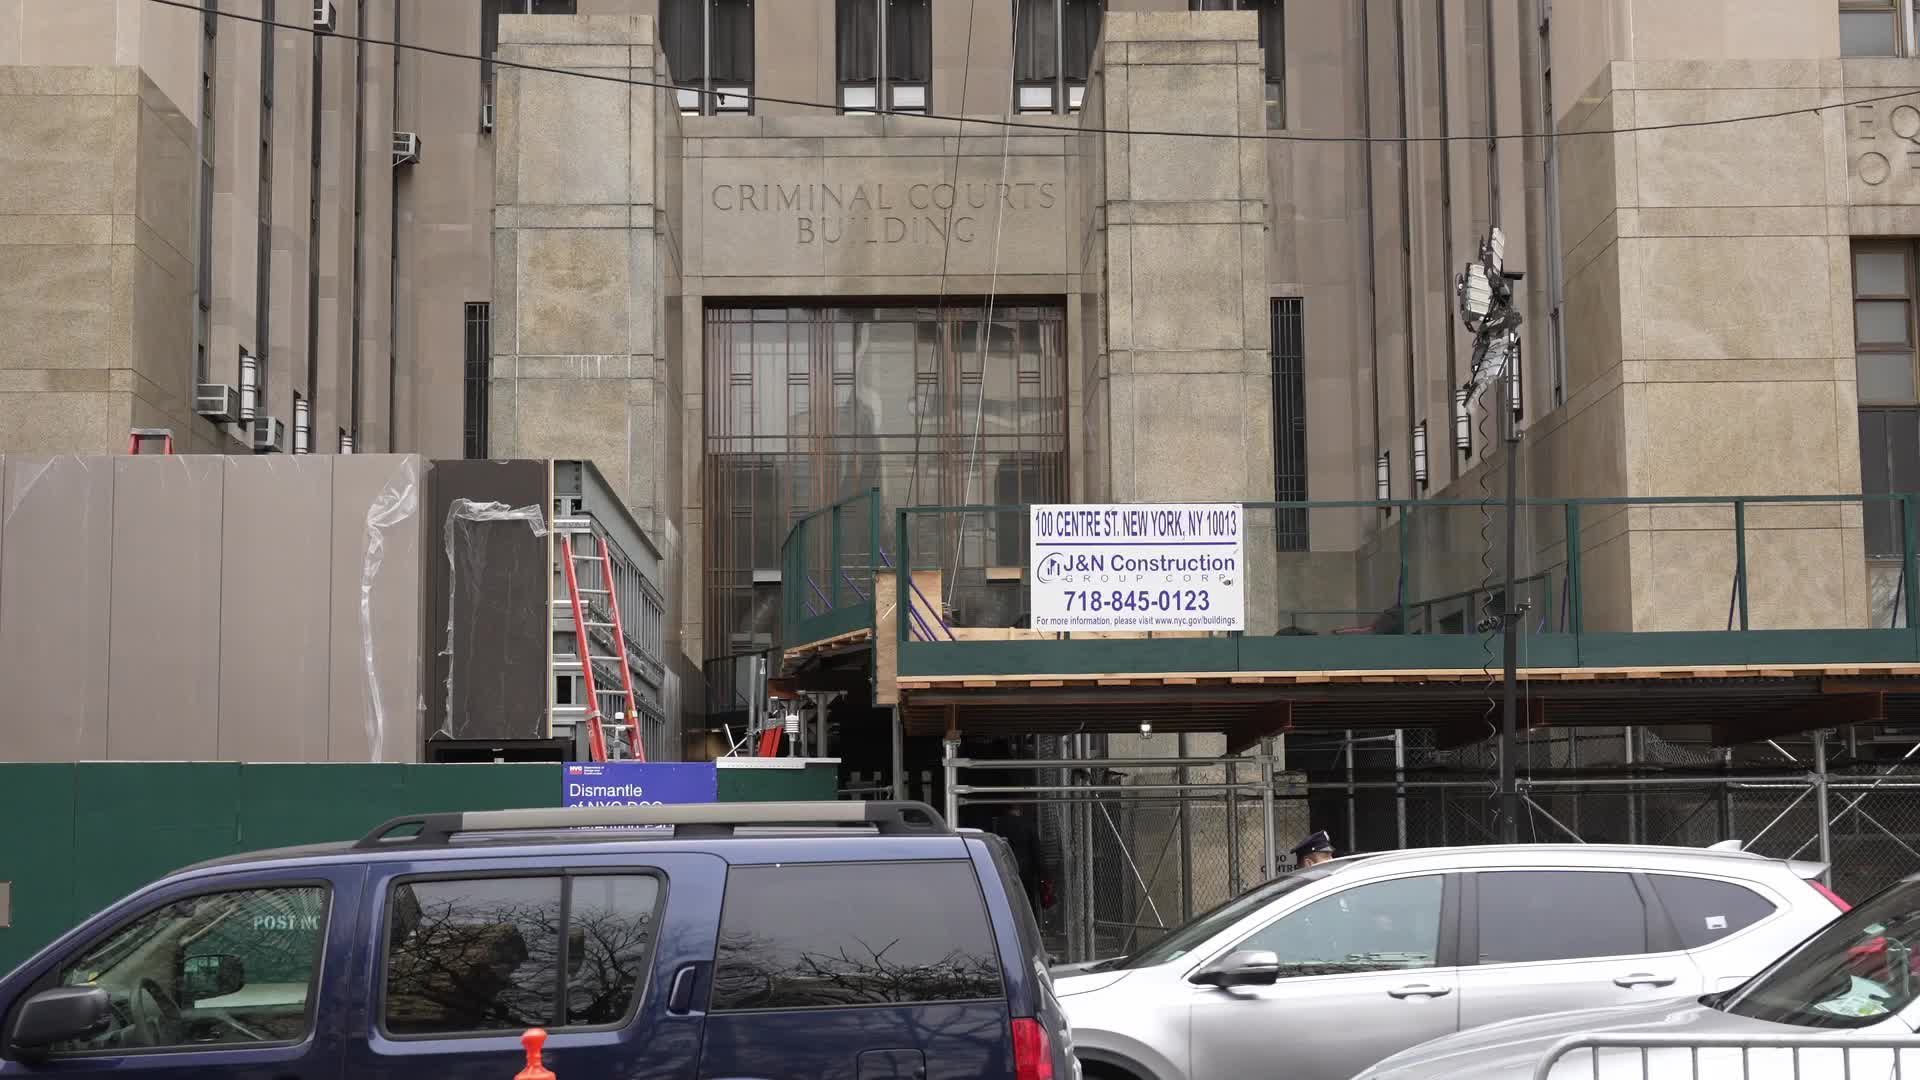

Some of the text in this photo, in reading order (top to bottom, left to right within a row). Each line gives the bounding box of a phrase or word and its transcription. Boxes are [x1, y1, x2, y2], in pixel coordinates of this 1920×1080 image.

[711, 183, 1056, 212] CRIMINAL COURTS
[796, 216, 976, 244] BUILDING
[1035, 510, 1237, 539] 100 CENTRE ST. NEW YORK, NY 10013
[1063, 554, 1235, 572] J&N Construction
[1065, 575, 1143, 583] GROUP
[1063, 589, 1210, 612] 718-845-0123
[1036, 616, 1049, 625] For
[1114, 616, 1137, 627] please
[1139, 616, 1154, 625] visit
[569, 783, 642, 797] Dismantle
[254, 915, 296, 930] POST
